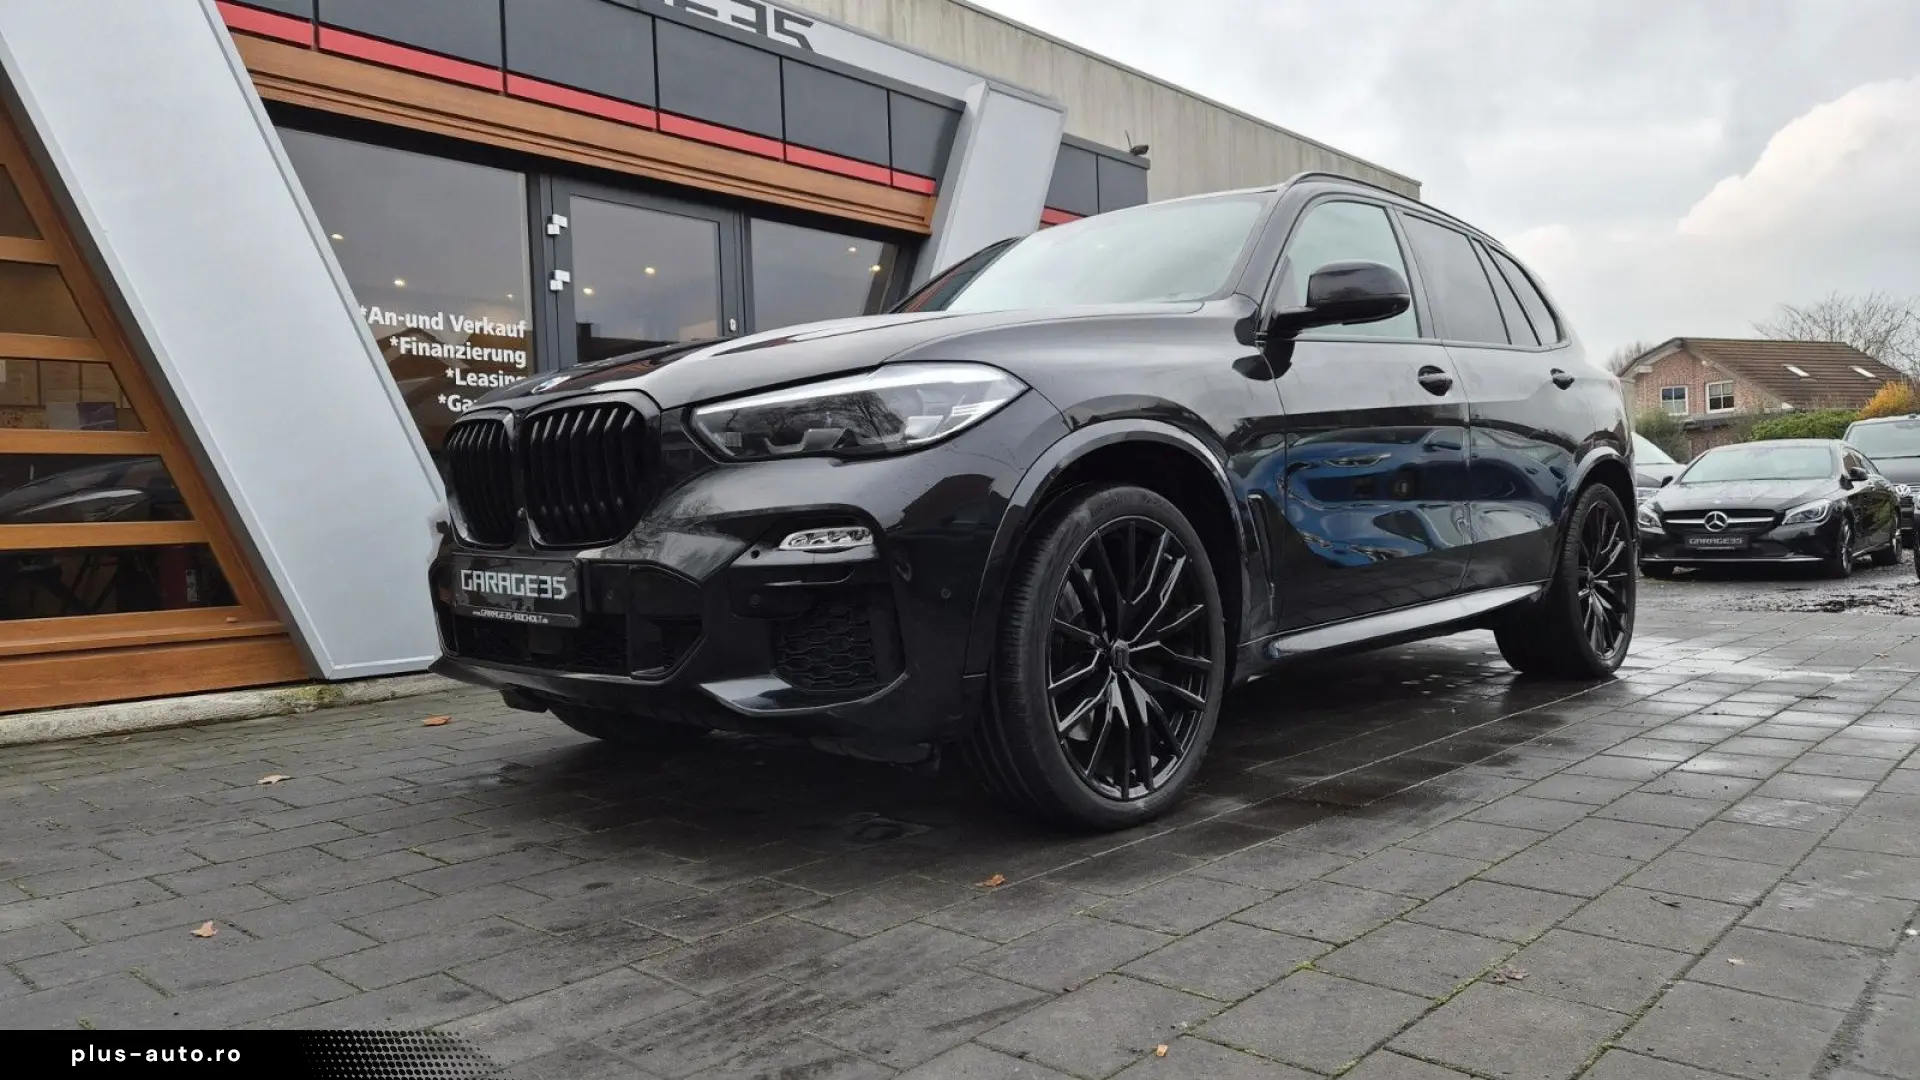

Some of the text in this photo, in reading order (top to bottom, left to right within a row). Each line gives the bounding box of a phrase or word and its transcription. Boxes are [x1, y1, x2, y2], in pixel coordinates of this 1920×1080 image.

[449, 313, 527, 338] Verkauf
[445, 367, 527, 388] Leasin
[460, 569, 567, 600] GARAGE35
